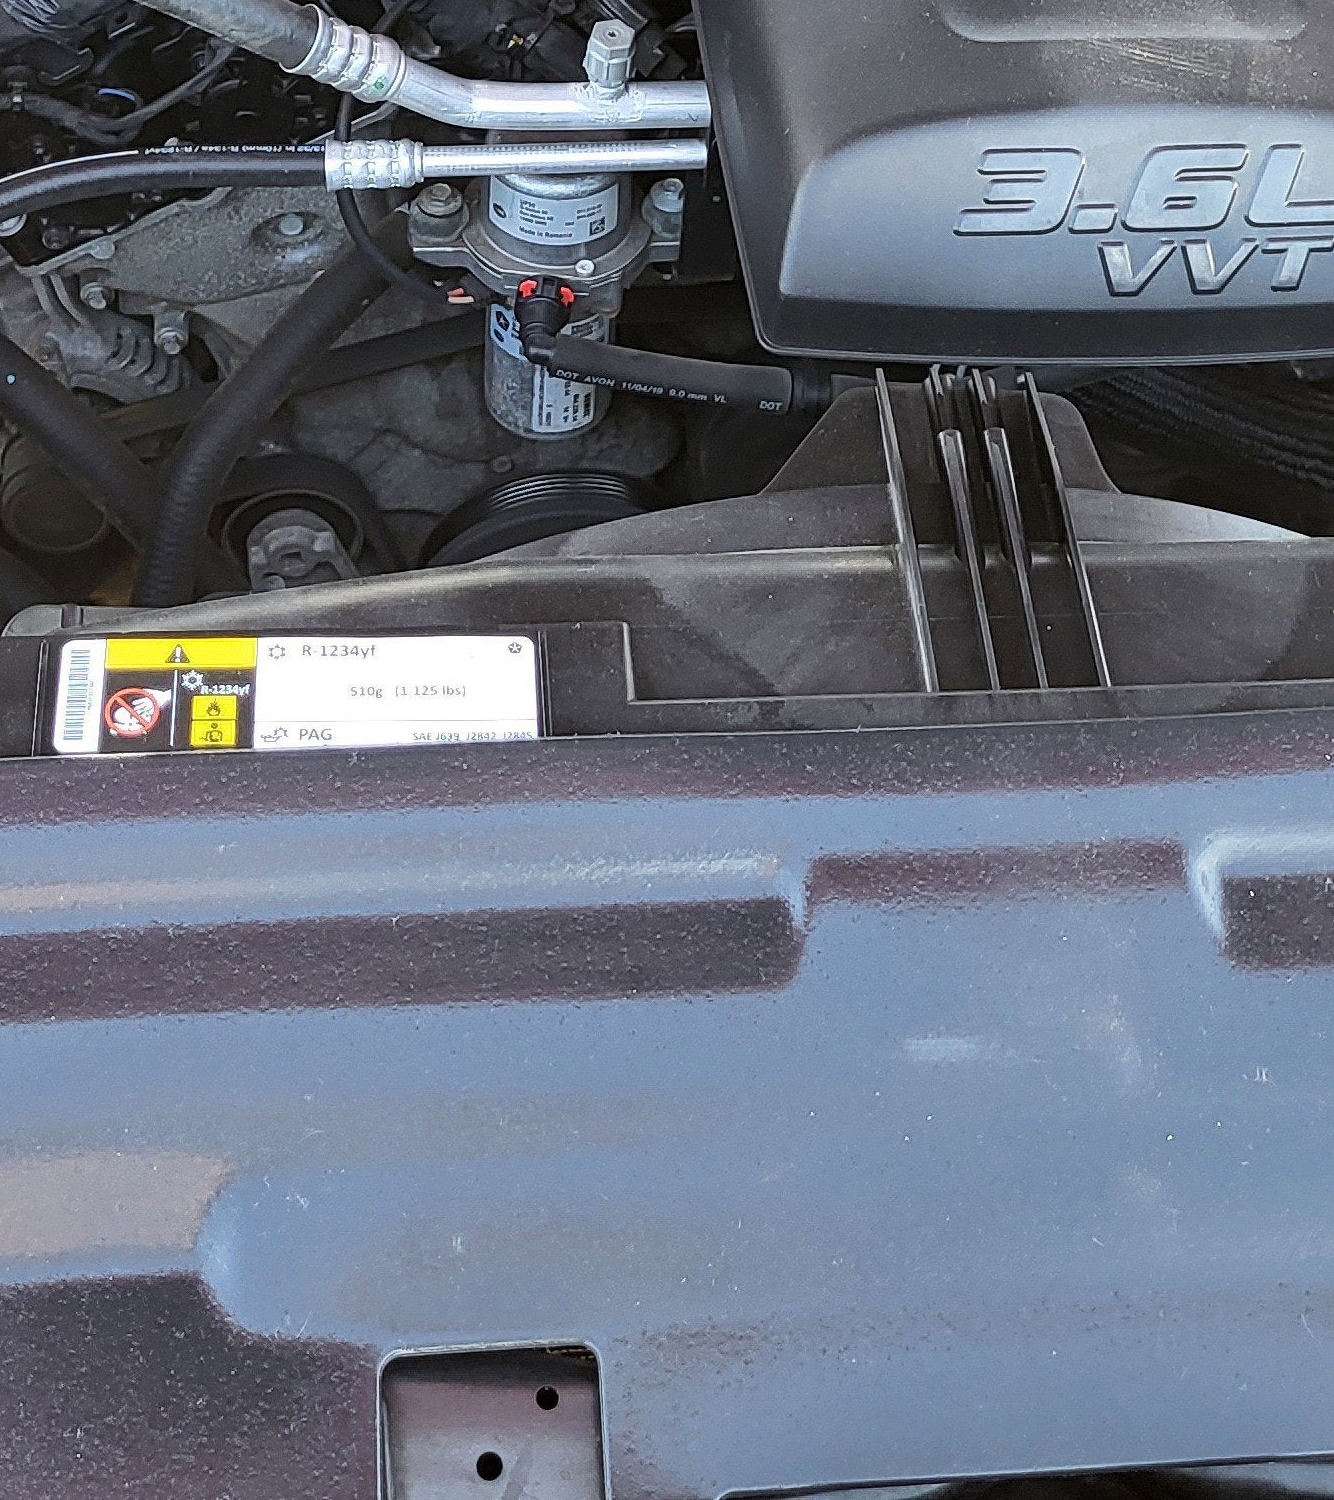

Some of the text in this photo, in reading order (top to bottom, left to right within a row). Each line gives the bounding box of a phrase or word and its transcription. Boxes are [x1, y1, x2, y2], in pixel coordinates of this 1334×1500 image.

[555, 369, 580, 380] DOT
[583, 375, 616, 387] AVON
[759, 400, 783, 412] DOT
[302, 644, 377, 660] R-1234yf
[200, 684, 251, 697] R-1234yf
[350, 686, 383, 699] 510g
[442, 685, 467, 697] lbs)
[299, 728, 333, 741] PAG
